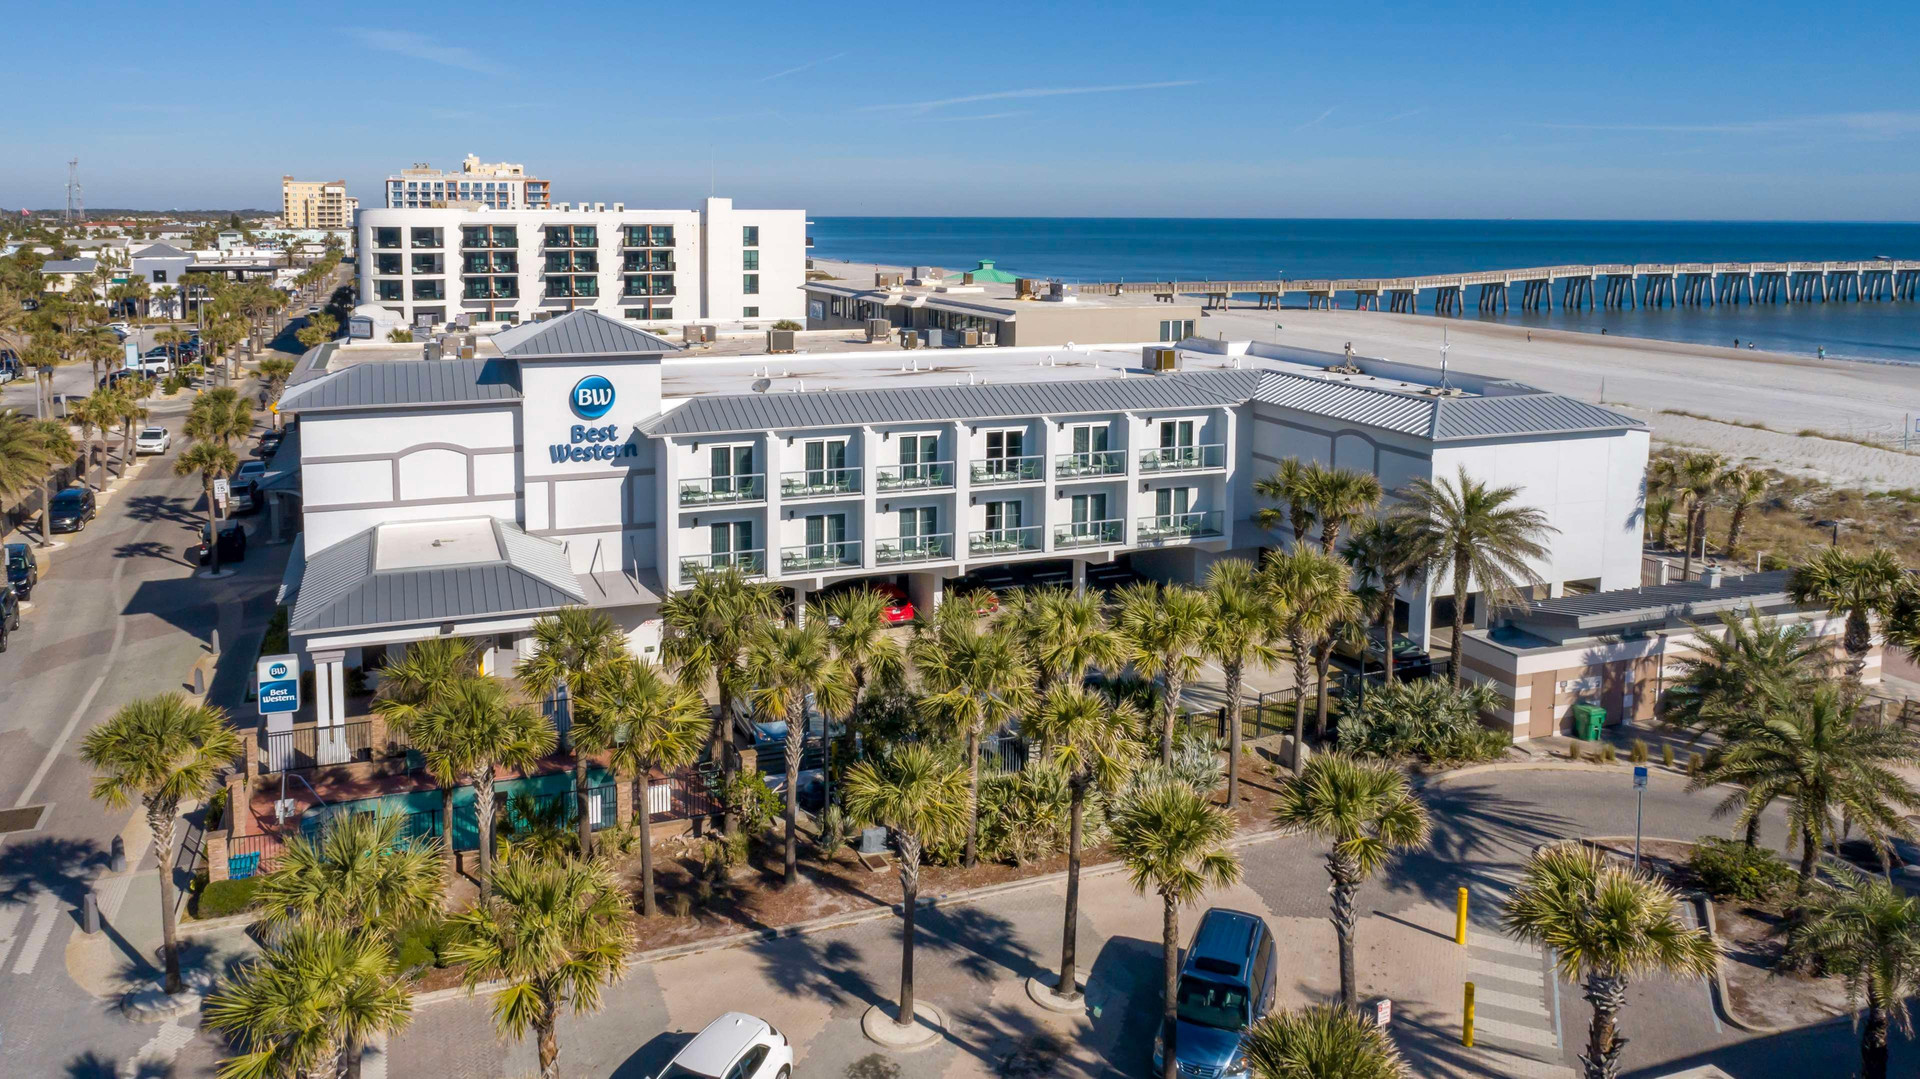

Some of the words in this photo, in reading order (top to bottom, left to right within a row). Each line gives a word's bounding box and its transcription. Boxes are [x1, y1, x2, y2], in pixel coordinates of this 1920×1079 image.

[578, 388, 612, 406] BW
[570, 424, 619, 444] Best
[549, 443, 638, 464] Western
[271, 667, 286, 676] BW
[270, 688, 288, 696] Best
[262, 695, 295, 703] Western
